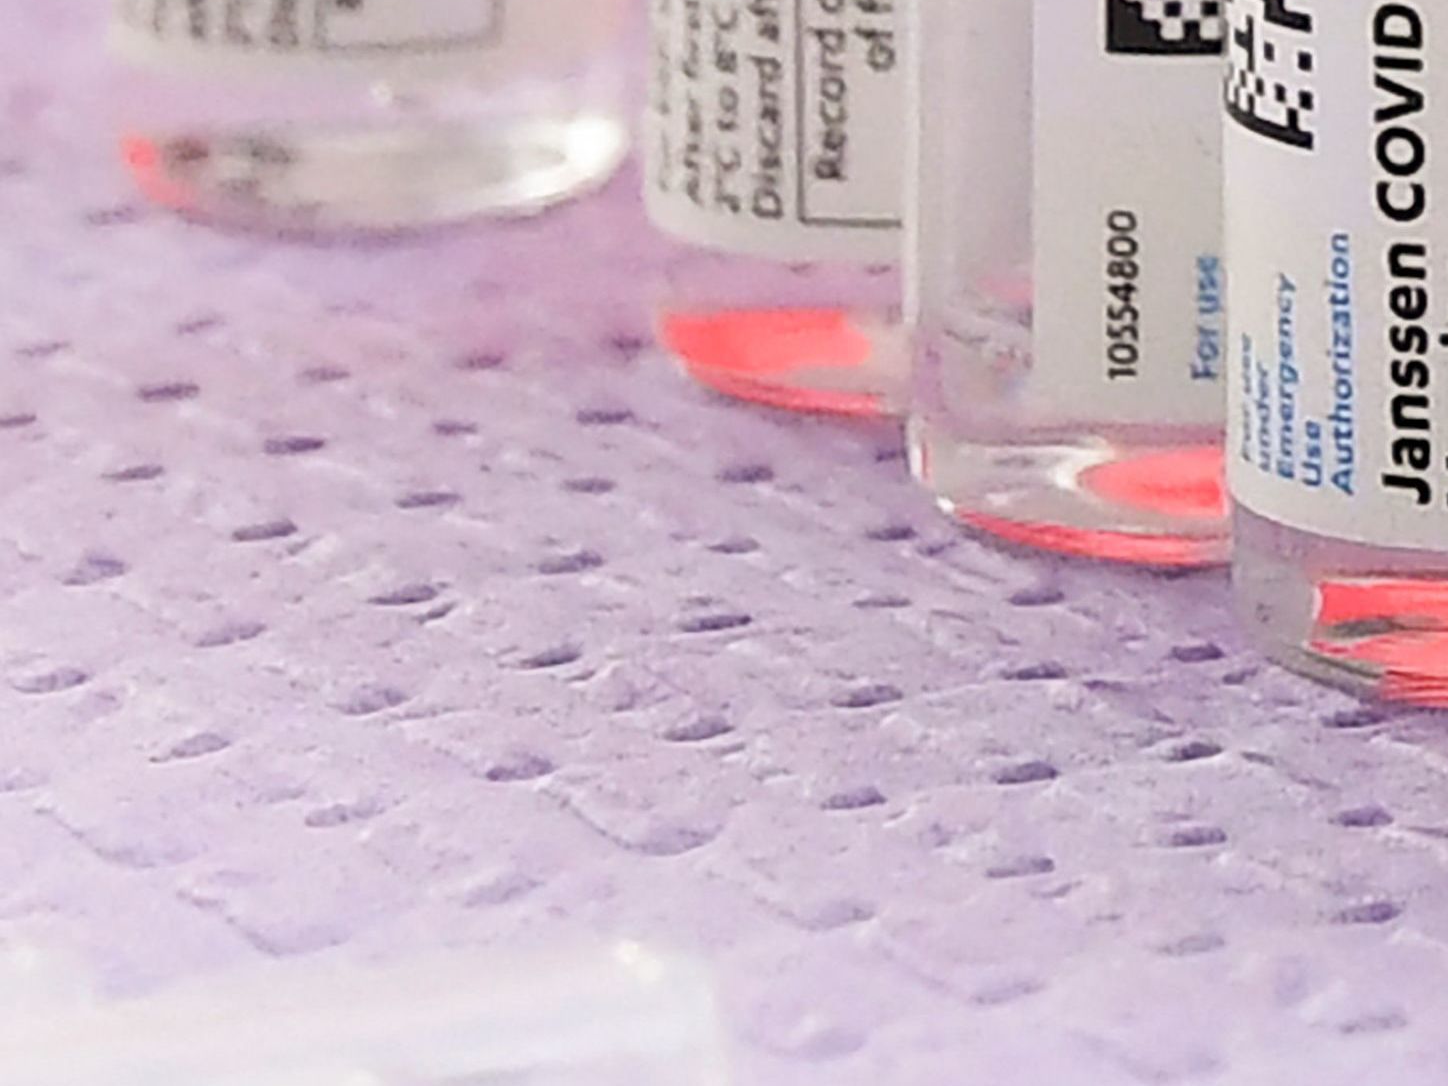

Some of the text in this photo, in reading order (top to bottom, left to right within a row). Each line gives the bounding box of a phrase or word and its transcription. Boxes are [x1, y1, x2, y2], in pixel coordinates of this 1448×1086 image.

[807, 28, 847, 181] Record
[854, 27, 897, 73] of
[750, 59, 784, 220] Discard
[1105, 209, 1140, 381] 10554800
[1190, 324, 1220, 380] For
[1277, 272, 1299, 479] Emergency
[1327, 233, 1355, 496] Authorization
[1381, 243, 1431, 506] Janssen
[1301, 420, 1323, 487] Use
